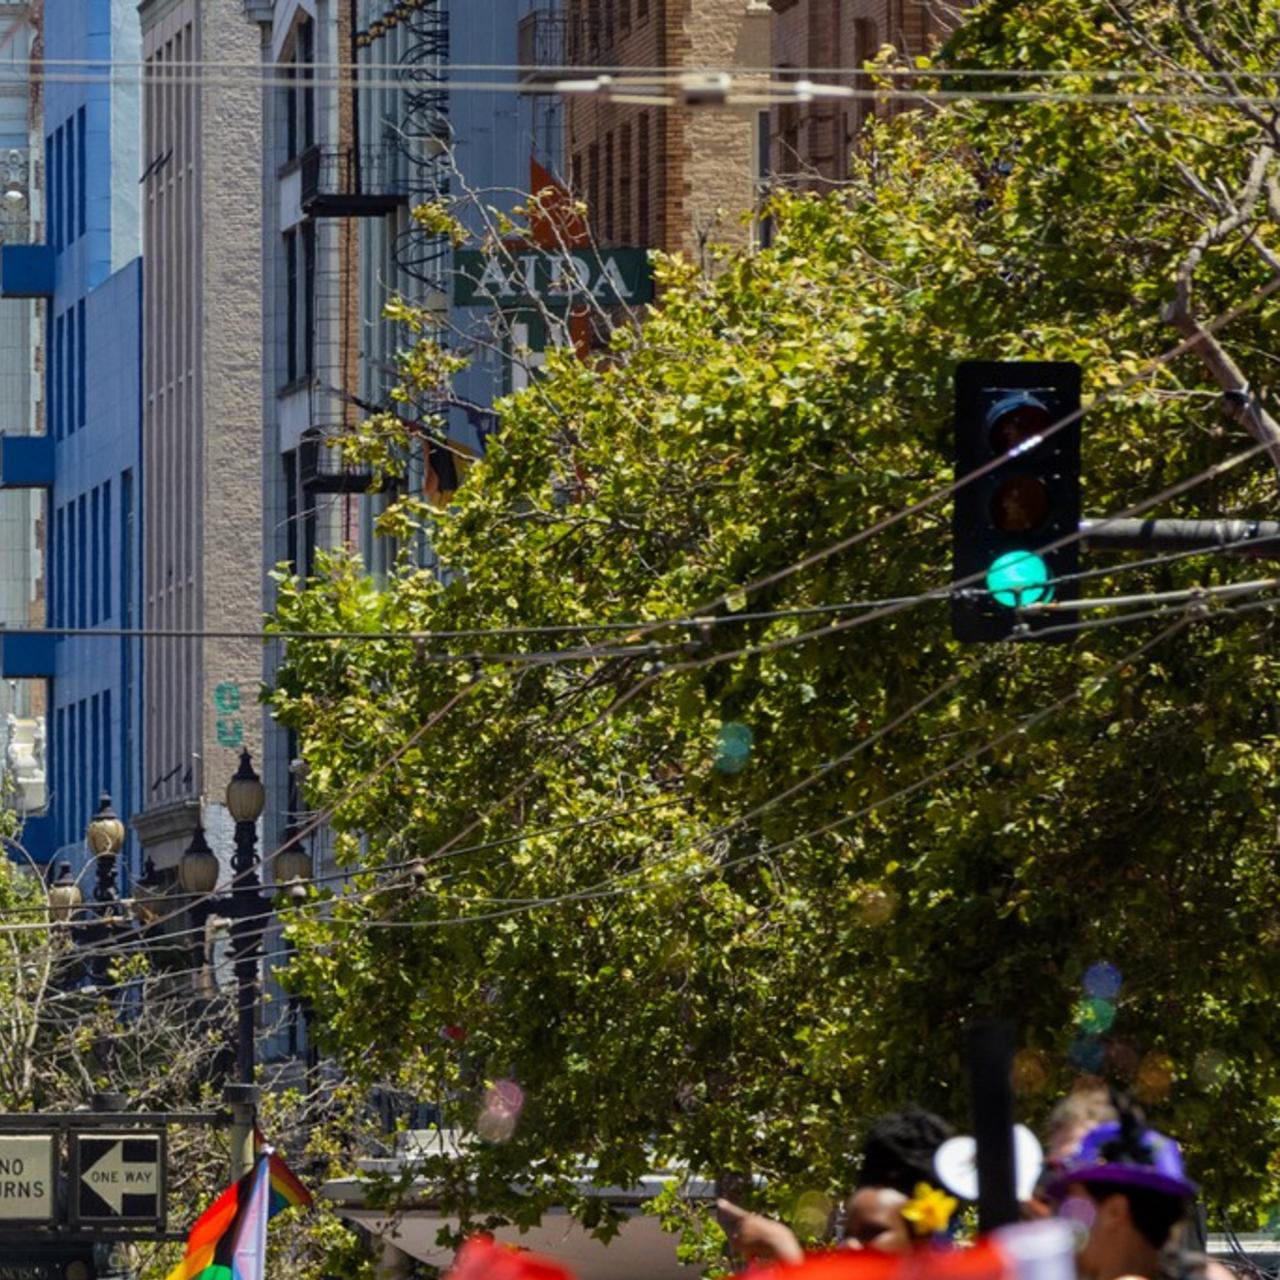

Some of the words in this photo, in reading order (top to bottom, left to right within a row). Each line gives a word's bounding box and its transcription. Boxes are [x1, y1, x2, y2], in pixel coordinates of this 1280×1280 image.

[472, 256, 634, 297] AIDA
[91, 1171, 118, 1183] ONE
[125, 1171, 152, 1183] WAY
